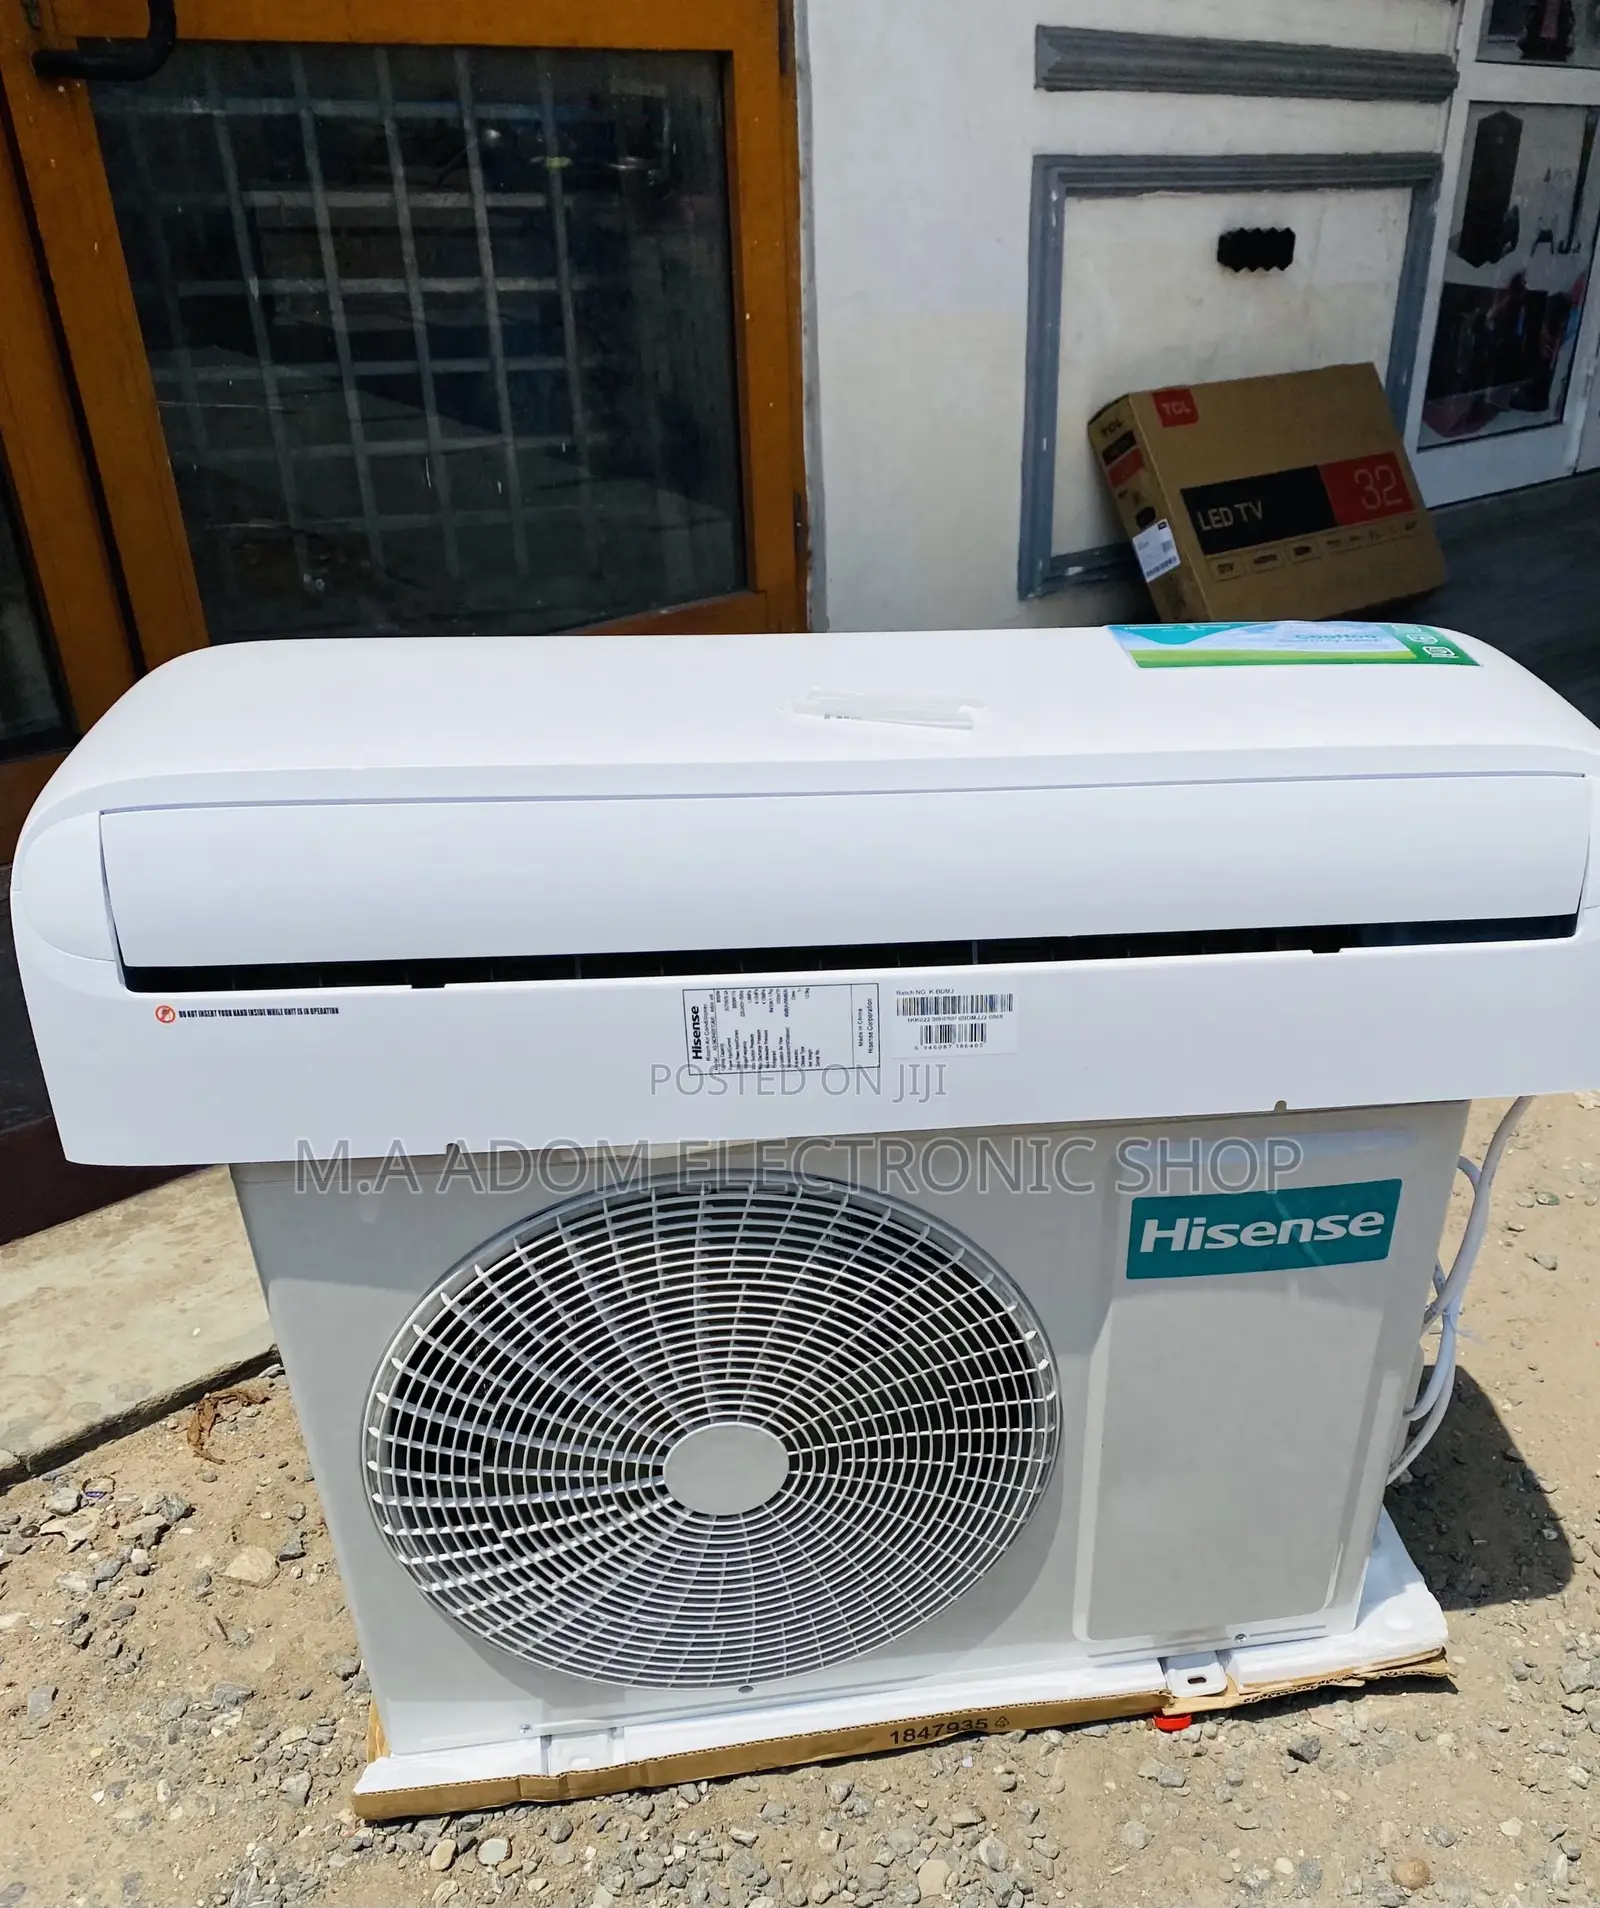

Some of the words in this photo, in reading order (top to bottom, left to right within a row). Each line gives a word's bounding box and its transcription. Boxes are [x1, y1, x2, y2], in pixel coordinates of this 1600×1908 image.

[1162, 400, 1191, 417] TCL
[1101, 418, 1123, 436] TCL
[1354, 465, 1402, 510] 32
[1198, 506, 1233, 531] LED
[1235, 501, 1263, 522] TV
[178, 1010, 186, 1018] DO
[187, 1010, 197, 1018] NOT
[266, 1008, 283, 1016] WHILE
[310, 1007, 339, 1015] OPERATION
[691, 1006, 702, 1059] Hisense
[1139, 1211, 1385, 1253] Hisense
[890, 1718, 988, 1745] 1847935
